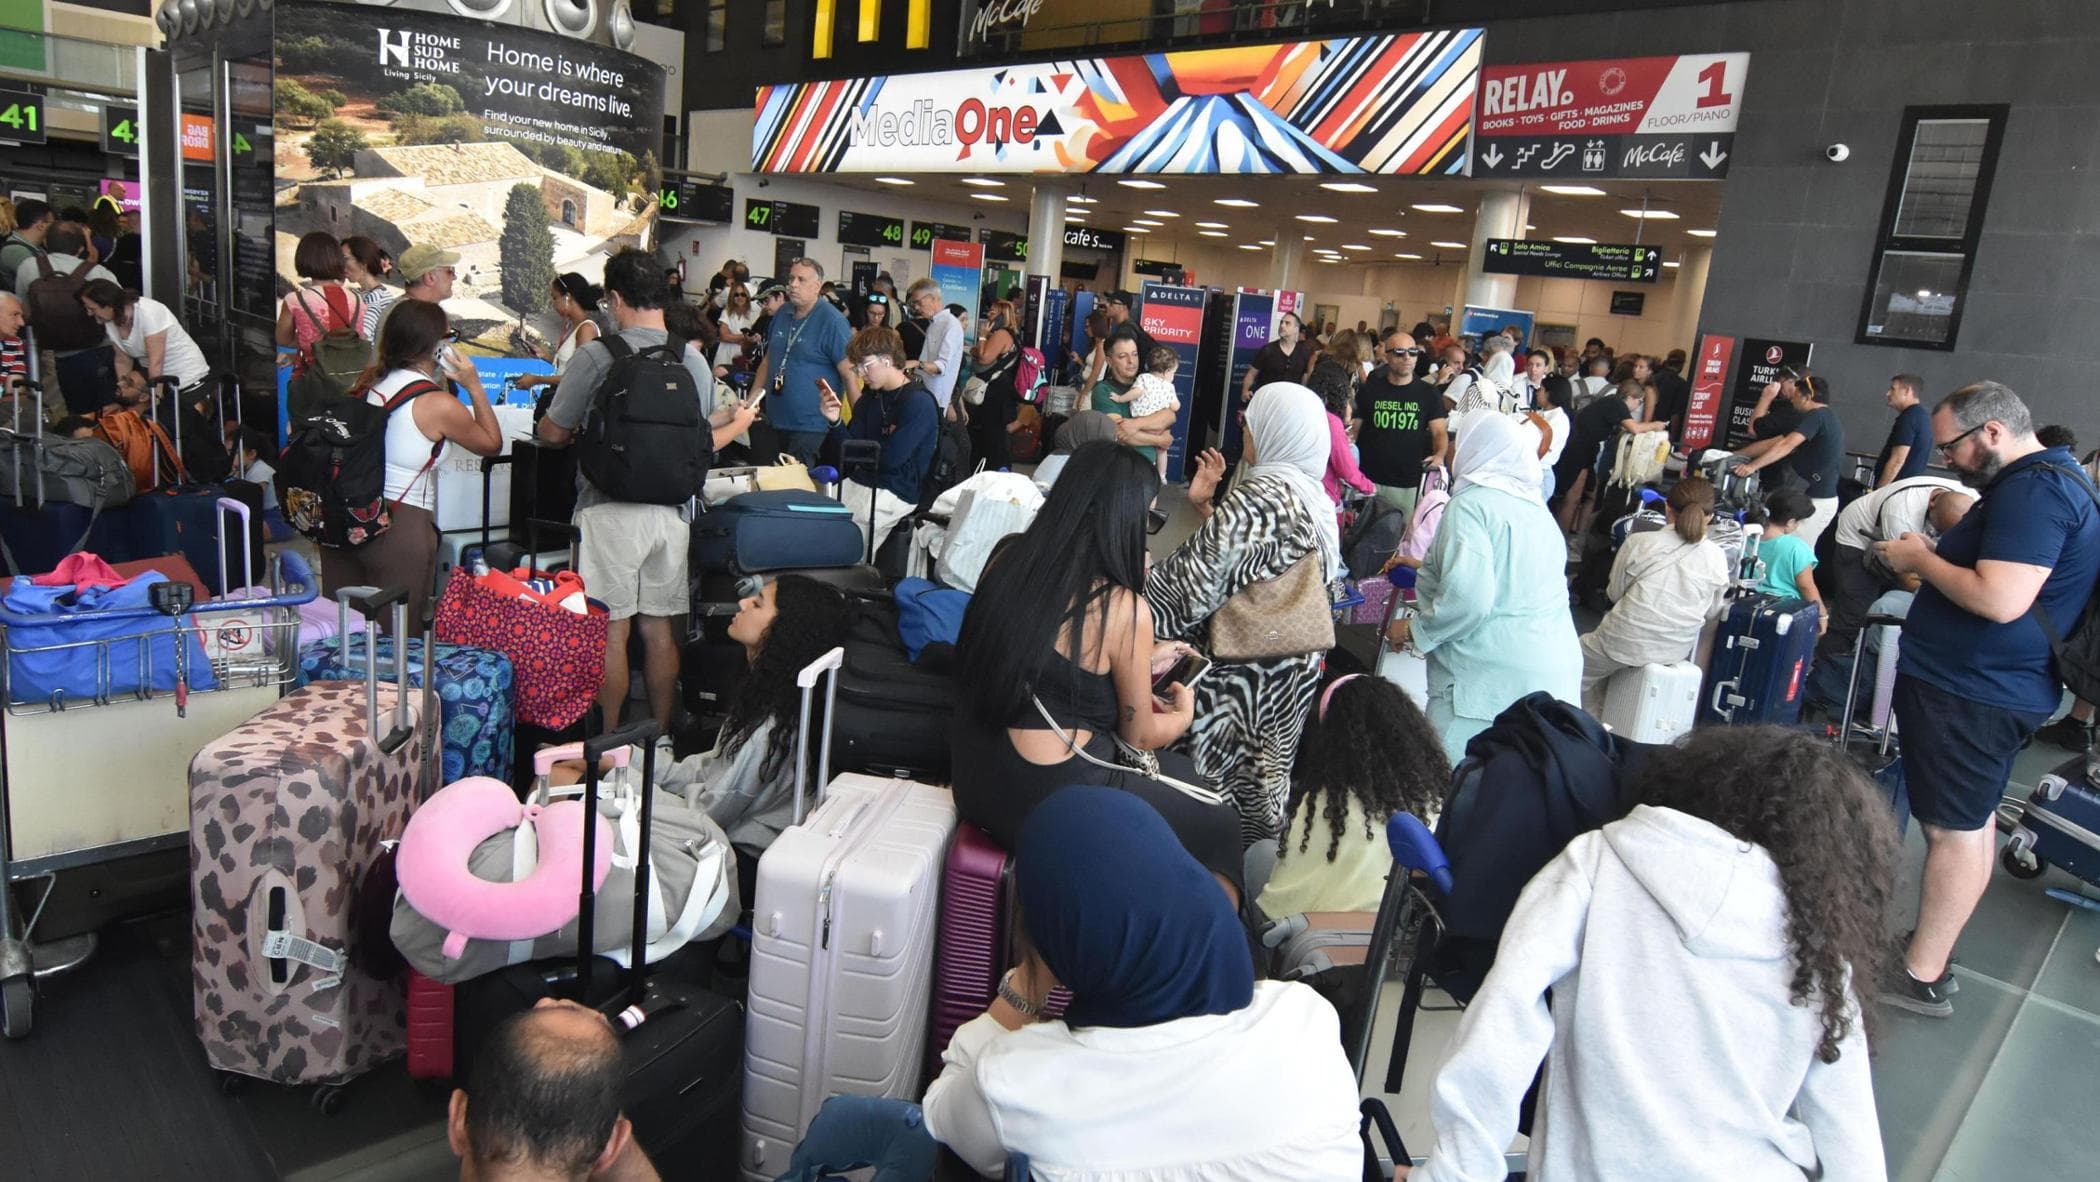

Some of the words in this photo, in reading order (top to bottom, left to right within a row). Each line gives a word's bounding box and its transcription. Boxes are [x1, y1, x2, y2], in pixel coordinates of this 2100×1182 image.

[415, 32, 461, 49] HOME
[414, 45, 444, 59] SUD
[414, 57, 460, 73] HOME
[487, 41, 555, 72] Home
[558, 54, 572, 75] is
[576, 61, 625, 88] where
[384, 69, 410, 80] Living
[414, 71, 437, 83] Sicily
[1696, 60, 1733, 109] 1
[484, 75, 535, 96] your
[538, 82, 607, 113] dreams
[609, 95, 633, 118] live.
[0, 103, 37, 132] 41
[484, 109, 508, 122] Find
[508, 114, 531, 128] your
[532, 118, 553, 130] new
[554, 120, 579, 133] home
[580, 124, 588, 135] in
[850, 97, 1038, 150] MediaOne
[1482, 118, 1514, 130] BOOKS
[1521, 113, 1544, 125] TOYS
[1550, 109, 1578, 122] GIFTS
[1584, 101, 1644, 118] MAGAZINES
[1558, 119, 1586, 131] FOOD
[1592, 113, 1630, 126] DRINKS
[1648, 108, 1731, 128] FLOOR/PIANO
[484, 125, 545, 142] surrounded
[545, 132, 555, 146] by
[557, 134, 587, 150] beauty
[587, 141, 602, 152] and
[1623, 142, 1685, 168] McCafé
[748, 206, 770, 225] 47
[882, 224, 901, 242] 48
[912, 228, 931, 246] 49
[1160, 291, 1191, 301] DELTA
[1143, 317, 1166, 327] SKY
[1143, 326, 1193, 338] PRIORITY
[1245, 325, 1266, 339] ONE
[1753, 365, 1779, 375] TURK
[1374, 401, 1402, 411] DIESEL
[1404, 402, 1420, 412] IND.
